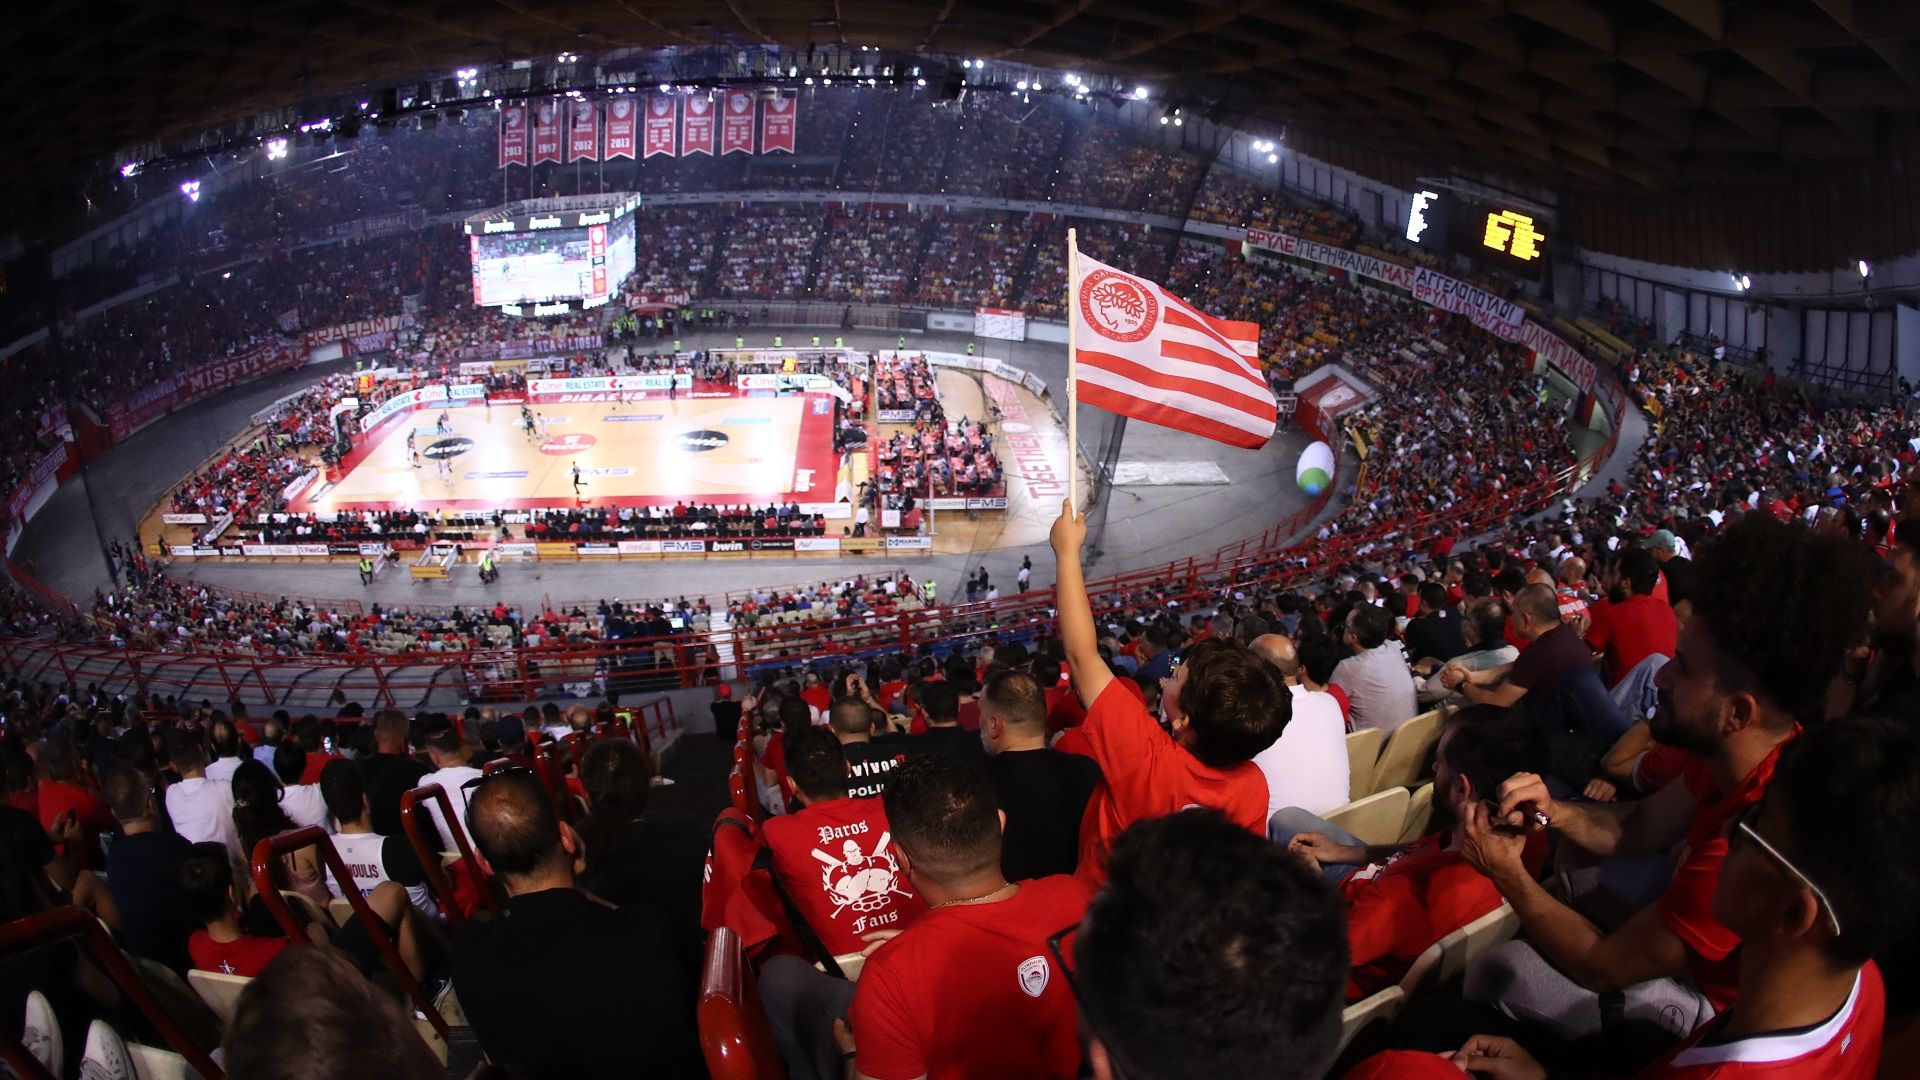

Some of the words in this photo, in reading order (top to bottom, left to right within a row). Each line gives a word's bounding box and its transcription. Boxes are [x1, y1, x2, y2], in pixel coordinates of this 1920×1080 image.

[574, 140, 593, 151] 2012
[610, 138, 630, 149] 2013
[1246, 228, 1297, 254] ΘΡΥΛΕ
[1300, 240, 1381, 276] ΠΕΡΗΦΑΝΙΑ
[1380, 263, 1414, 289] ΜΑΣ
[1415, 268, 1516, 321] ΑΓΓΕΛΟΠΟΥΛΟΙ
[189, 346, 275, 393] MISFITS
[566, 381, 583, 390] REAL
[583, 380, 606, 389] ESTATE
[646, 378, 663, 387] REAL
[879, 411, 912, 420] FMS
[968, 498, 1007, 508] FMS
[663, 541, 703, 551] FMS
[712, 541, 743, 552] bwin
[848, 758, 899, 778] VIVOR
[817, 820, 869, 845] Paros
[852, 909, 899, 935] Fans
